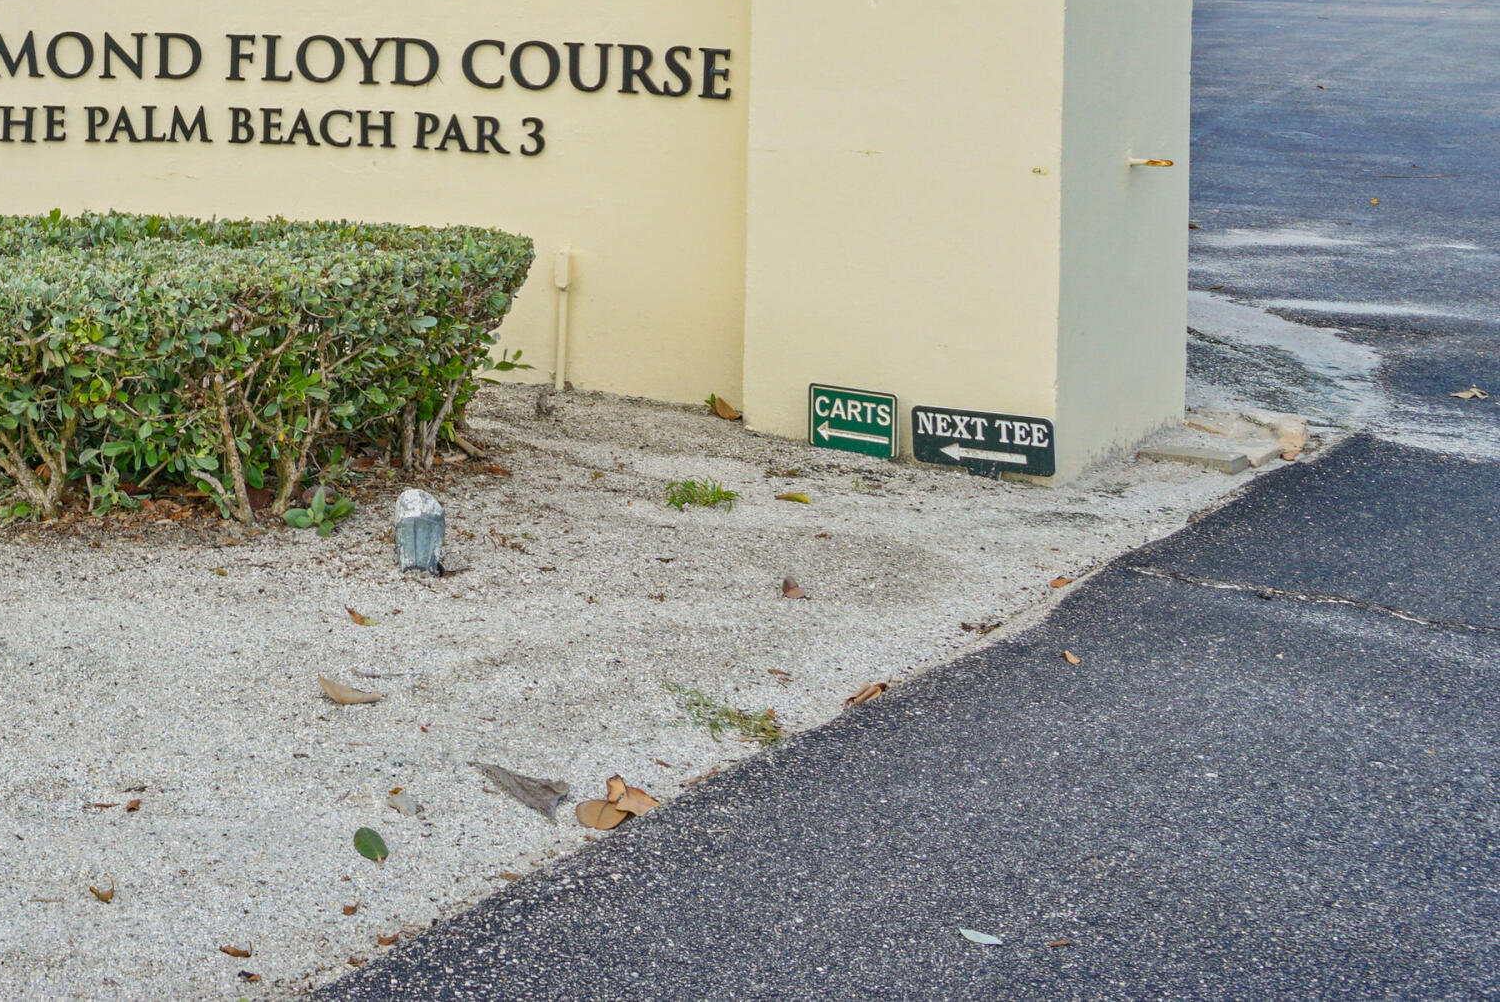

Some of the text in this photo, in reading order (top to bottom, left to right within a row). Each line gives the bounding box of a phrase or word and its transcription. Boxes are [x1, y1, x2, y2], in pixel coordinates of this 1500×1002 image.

[225, 33, 440, 87] FLOYD
[461, 38, 732, 100] COURSE
[83, 105, 213, 144] PALM
[228, 106, 396, 148] BEACH
[413, 111, 510, 155] PAR
[520, 116, 546, 156] 3
[814, 395, 891, 426] CARTS
[916, 410, 1050, 448] NEXT TEE
